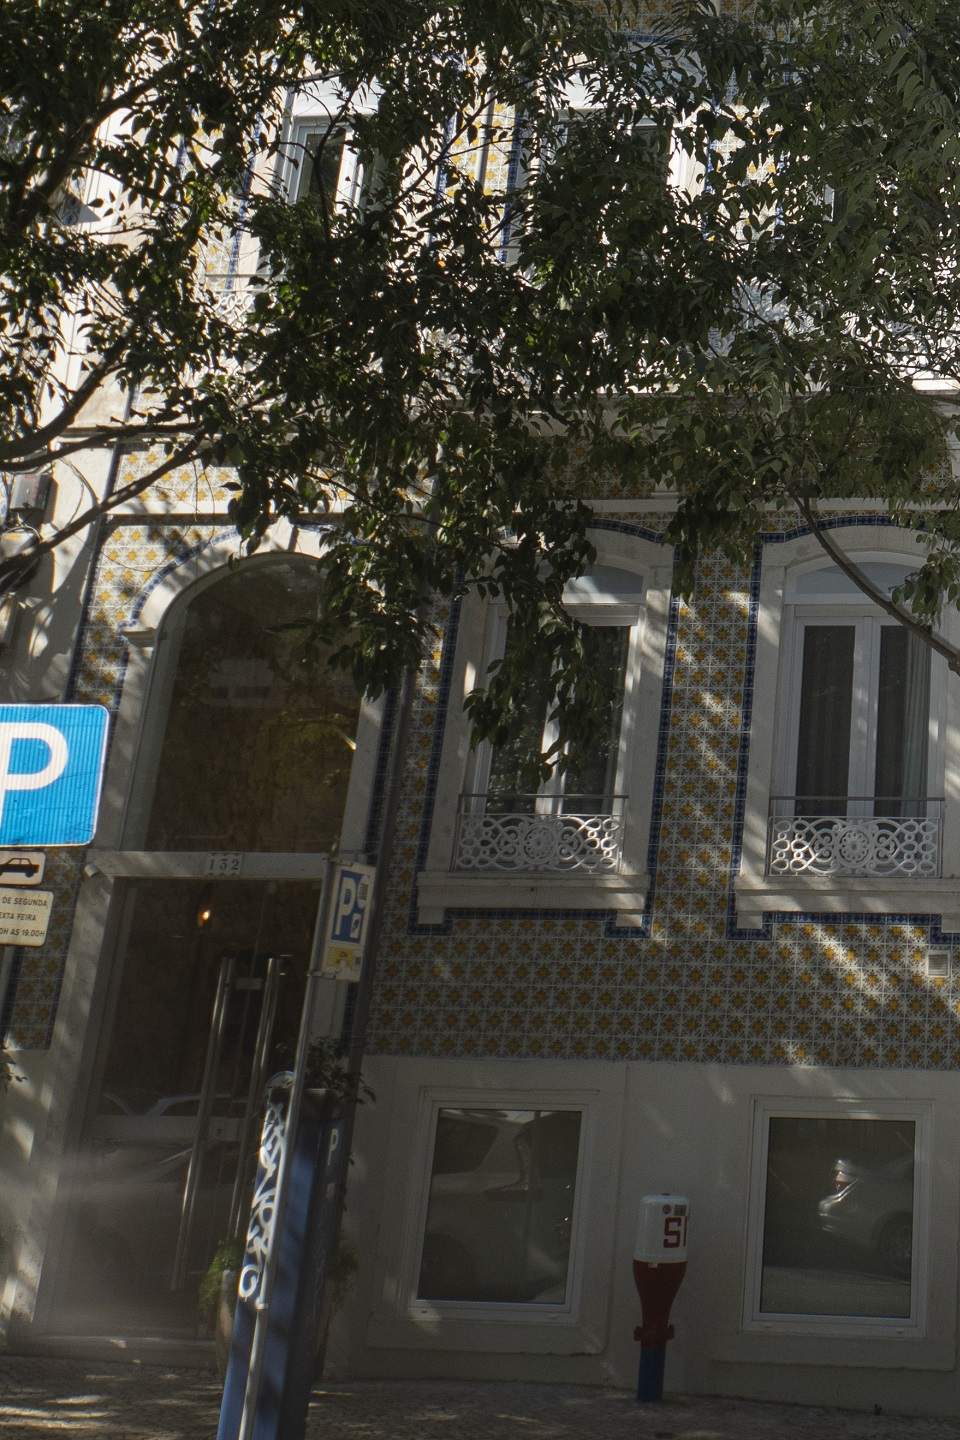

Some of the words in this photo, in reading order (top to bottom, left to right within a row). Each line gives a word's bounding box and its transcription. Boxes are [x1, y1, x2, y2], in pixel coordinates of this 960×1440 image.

[0, 722, 69, 830] P
[13, 897, 48, 907] SEGUNDA
[17, 913, 36, 921] FEIRA
